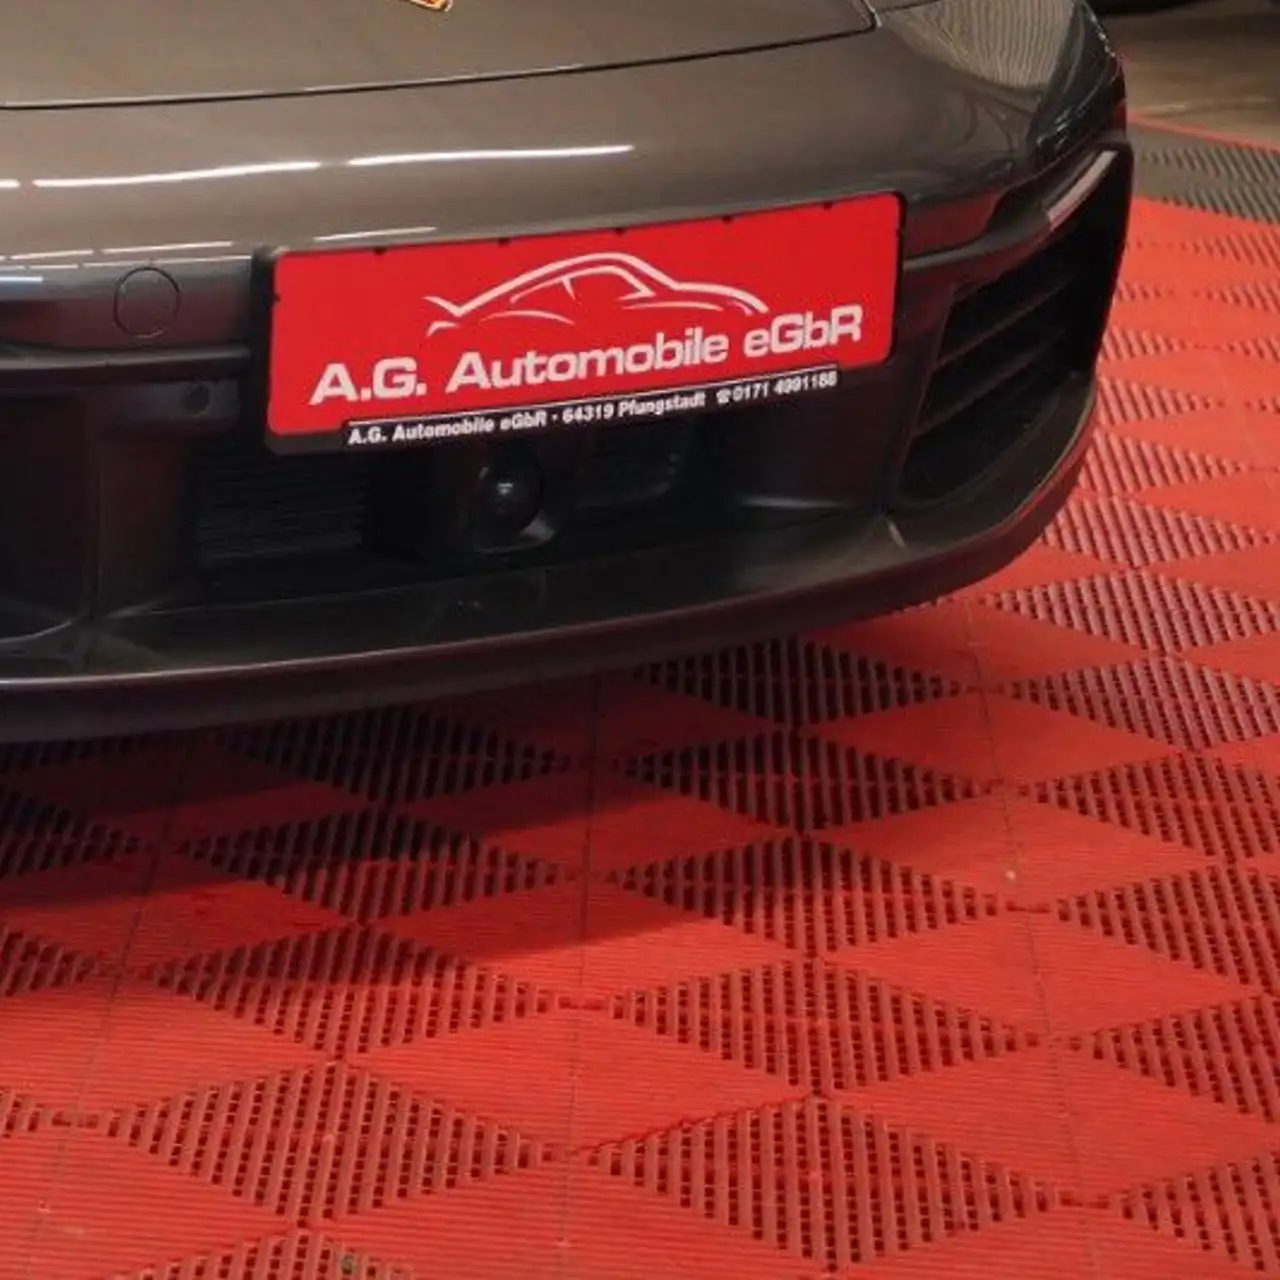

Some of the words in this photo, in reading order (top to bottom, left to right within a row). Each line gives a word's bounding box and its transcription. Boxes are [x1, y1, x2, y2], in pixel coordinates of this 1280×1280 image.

[308, 356, 428, 406] A.G.
[445, 326, 730, 394] Automobile
[743, 304, 864, 358] eGbR
[348, 426, 388, 445] A.G.
[391, 416, 496, 442] Automobile
[500, 410, 547, 431] eGbR
[562, 402, 615, 424] 64319
[618, 391, 706, 417] Pfungstadt
